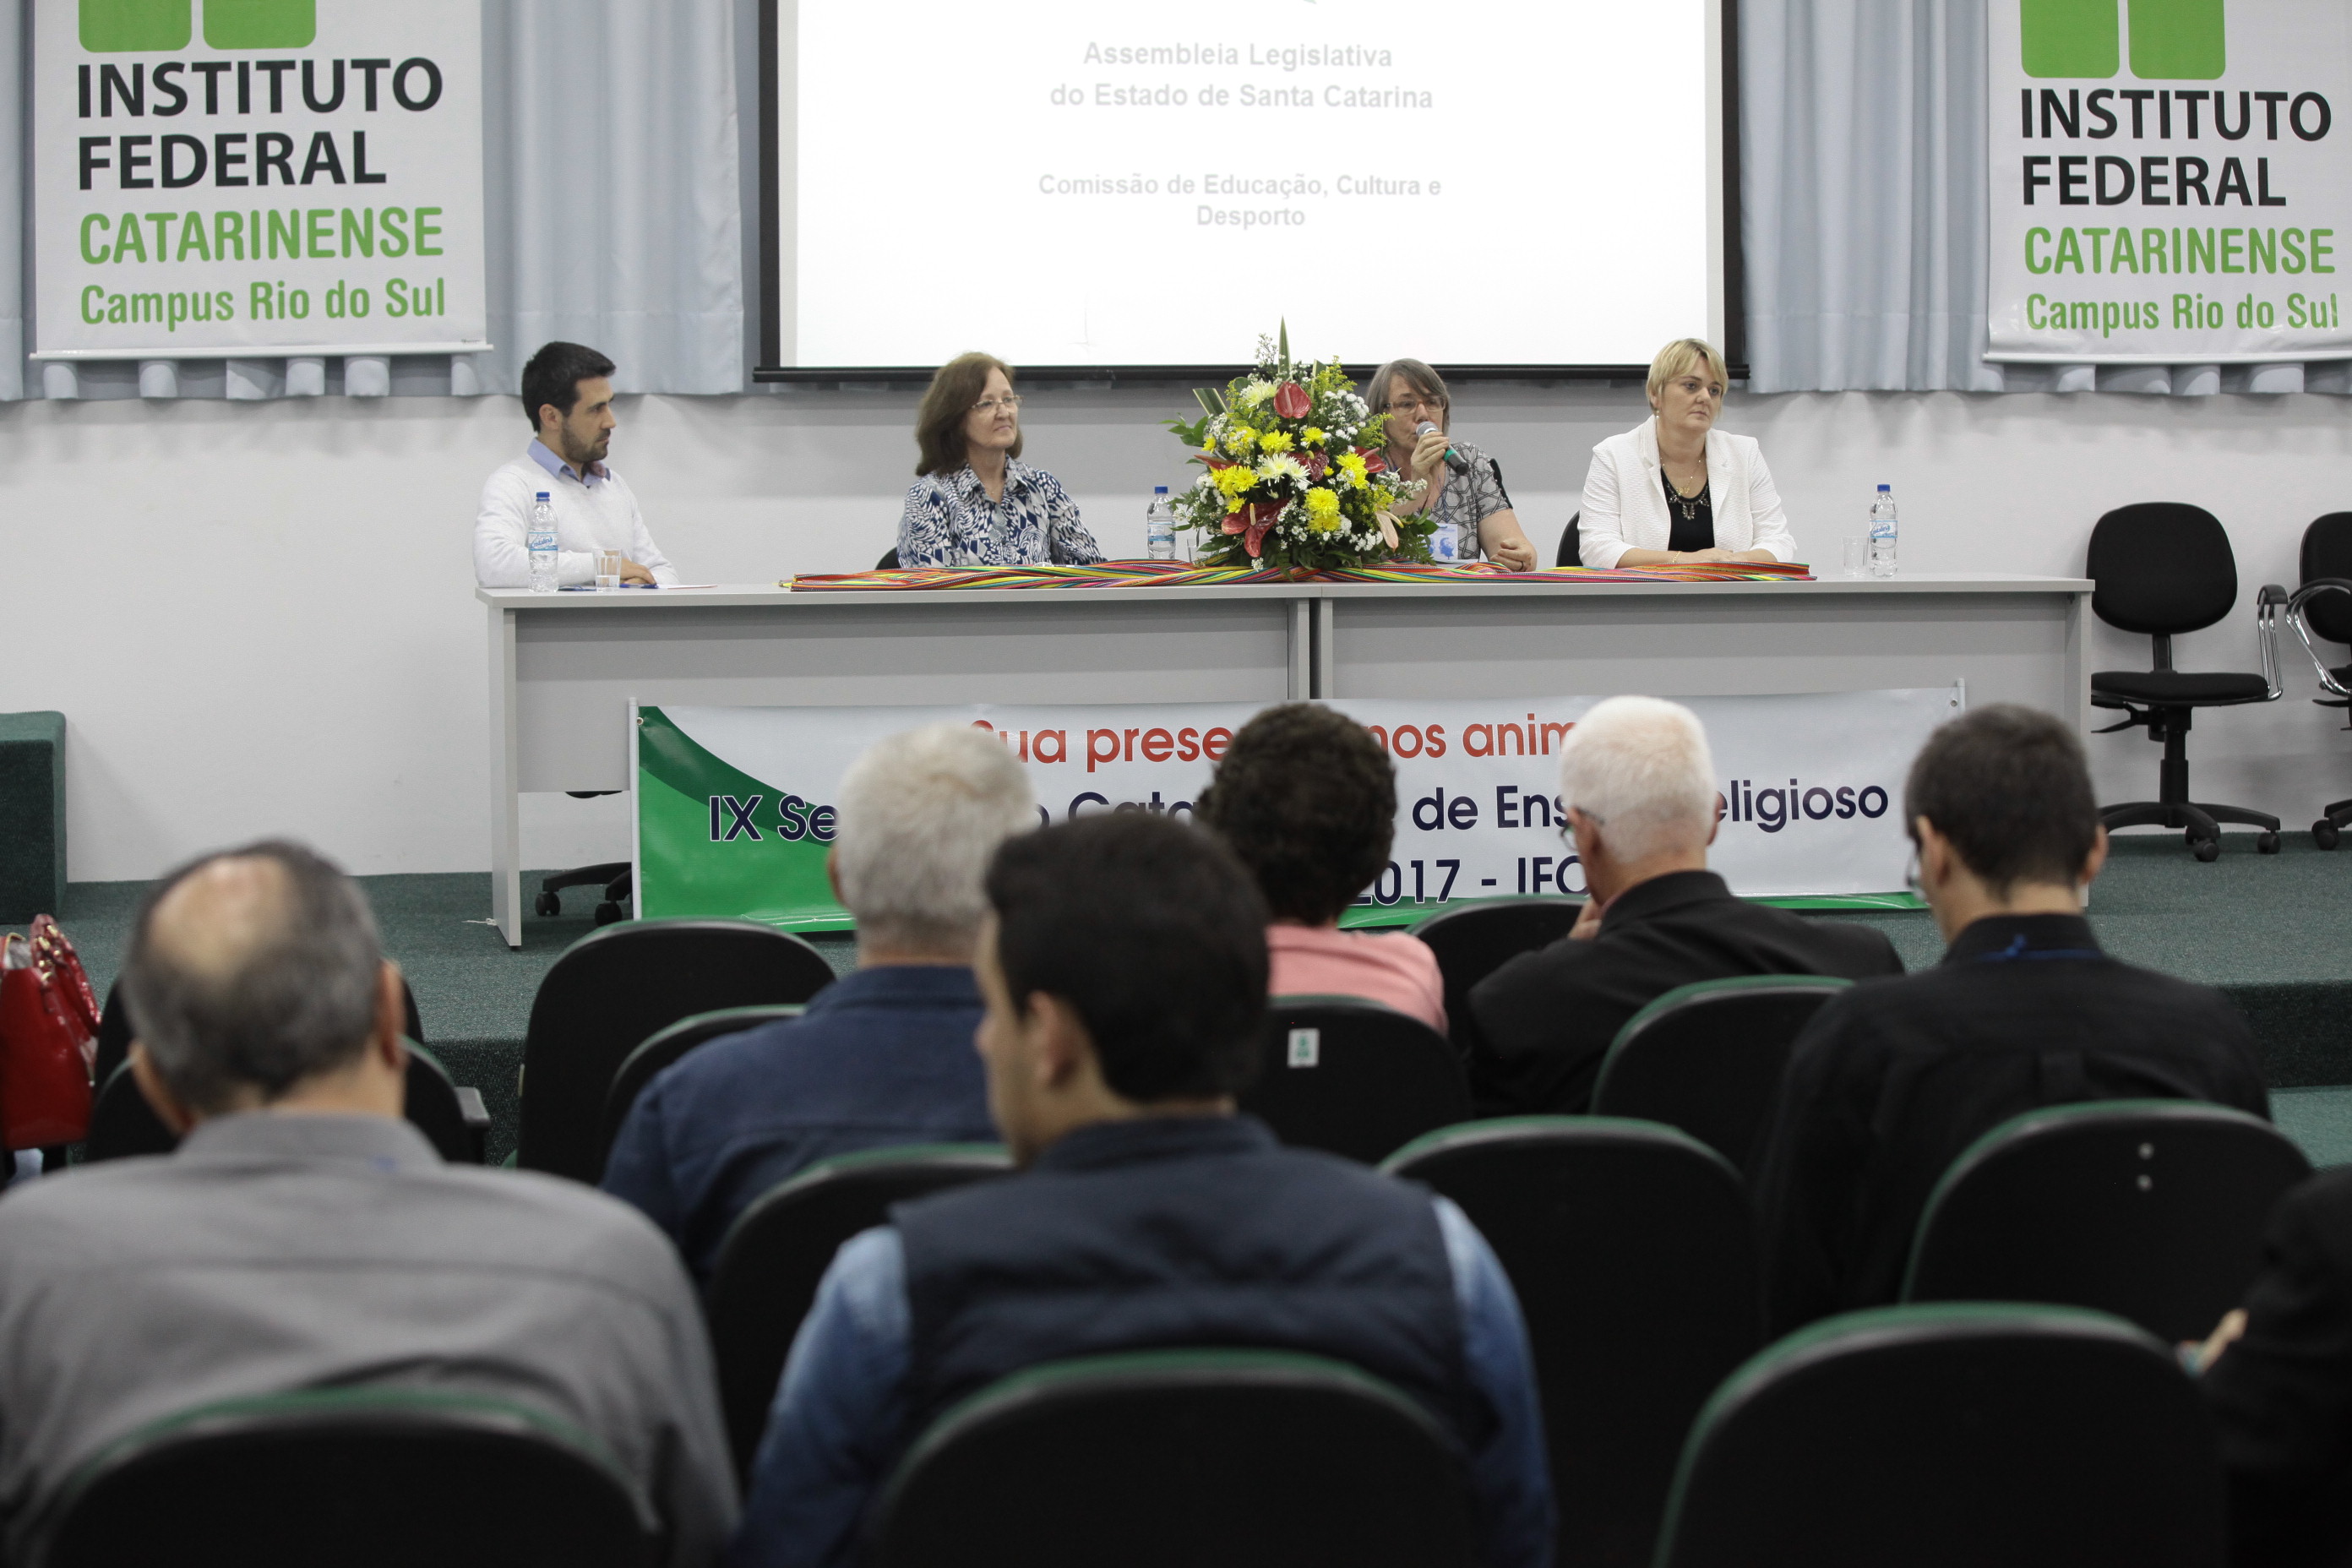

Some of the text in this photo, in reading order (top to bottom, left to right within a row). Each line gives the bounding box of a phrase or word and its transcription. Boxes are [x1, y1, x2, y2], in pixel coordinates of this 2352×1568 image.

[1083, 41, 1392, 72] Assembleia Legislativa
[79, 57, 443, 118] INSTITUTO
[1050, 83, 1433, 108] do Estado de Santa Catarina
[2021, 88, 2332, 142] INSTITUTO
[79, 130, 387, 191] FEDERAL
[1038, 172, 1441, 199] Comissão de Educação, Cultura e
[2023, 155, 2287, 207] FEDERAL
[80, 206, 444, 264] CATARINENSE
[1197, 204, 1305, 231] Desporto
[2024, 226, 2336, 275] CATARINENSE
[81, 277, 444, 332] Campus Rio do Sul
[2026, 292, 2339, 338] Campus Rio do Sul
[709, 794, 764, 841] IX
[1412, 787, 1478, 830] de
[1350, 858, 1461, 906] 017
